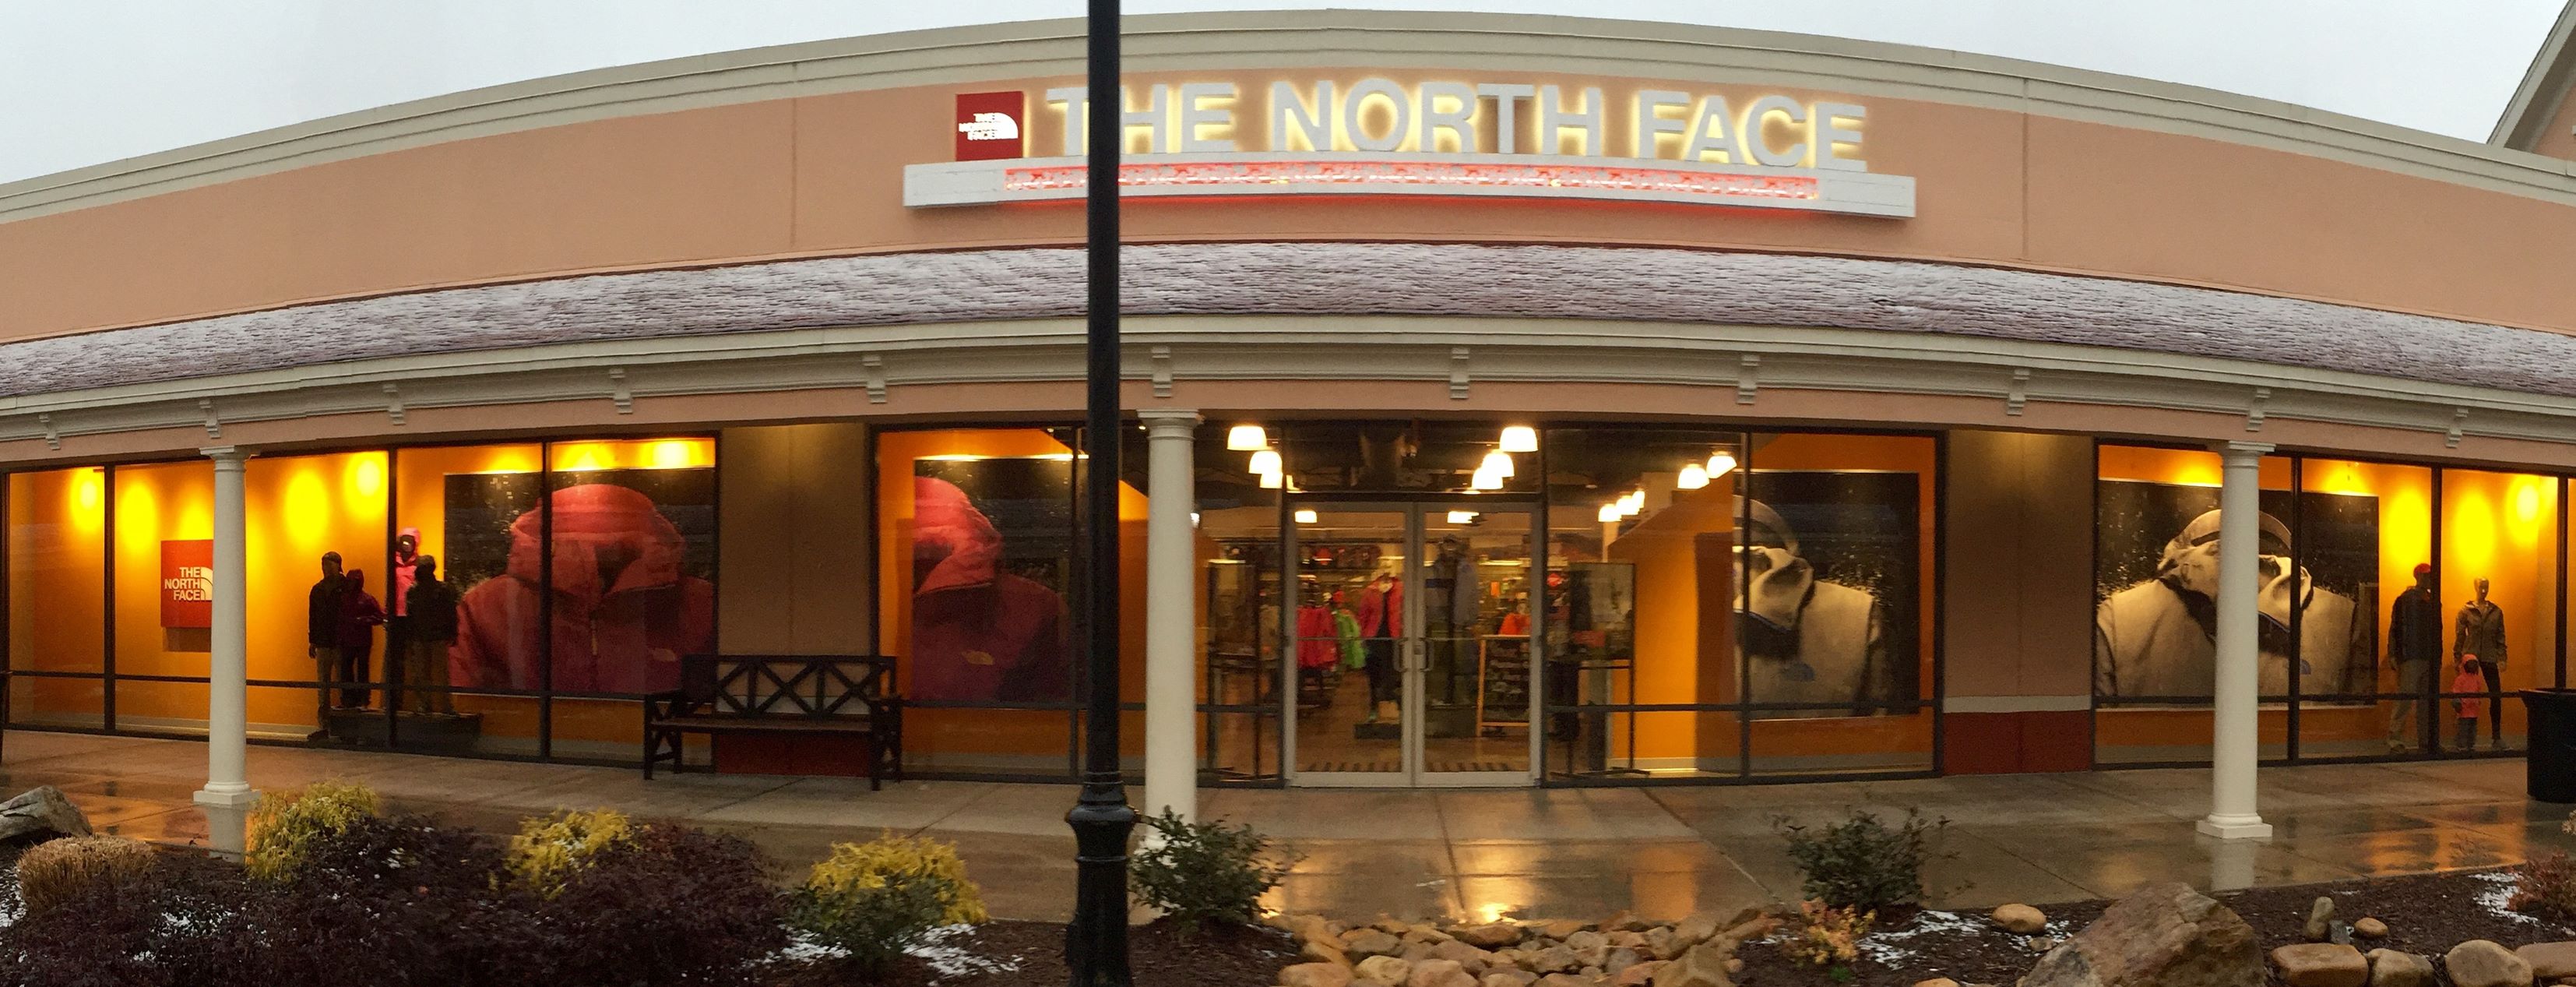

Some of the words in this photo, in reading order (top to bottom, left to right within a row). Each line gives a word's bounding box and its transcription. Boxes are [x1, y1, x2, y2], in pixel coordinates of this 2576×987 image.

[1047, 82, 1237, 156] THE
[1272, 76, 1601, 156] NORTH
[1637, 89, 1867, 172] FACE
[179, 566, 200, 578] THE
[164, 578, 200, 590] NORTH
[173, 590, 200, 601] FACE
